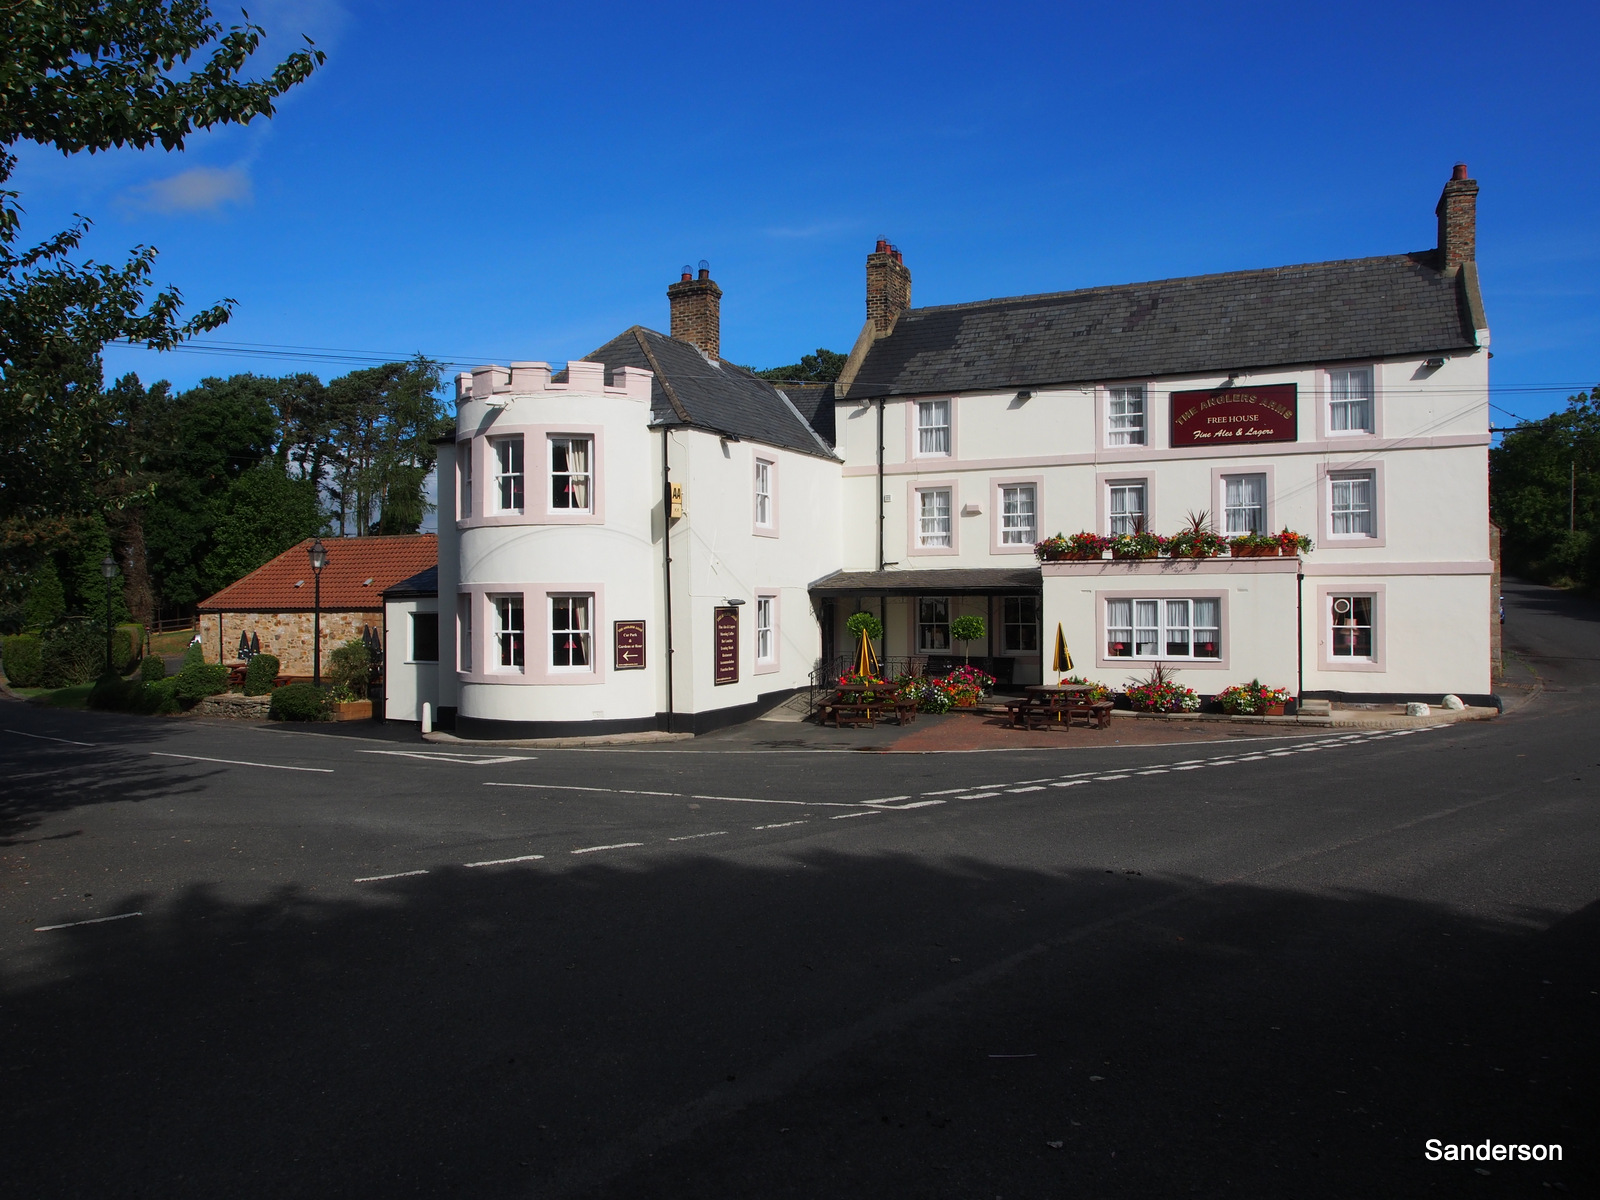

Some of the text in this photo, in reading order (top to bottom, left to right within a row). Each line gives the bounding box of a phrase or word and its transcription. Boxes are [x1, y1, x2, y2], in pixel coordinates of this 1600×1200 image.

[1175, 394, 1293, 425] THE ANGLERS ARMS
[1207, 414, 1259, 424] FREE HOUSE
[1193, 427, 1274, 439] Fine Ales & Lagers
[672, 487, 681, 499] AA
